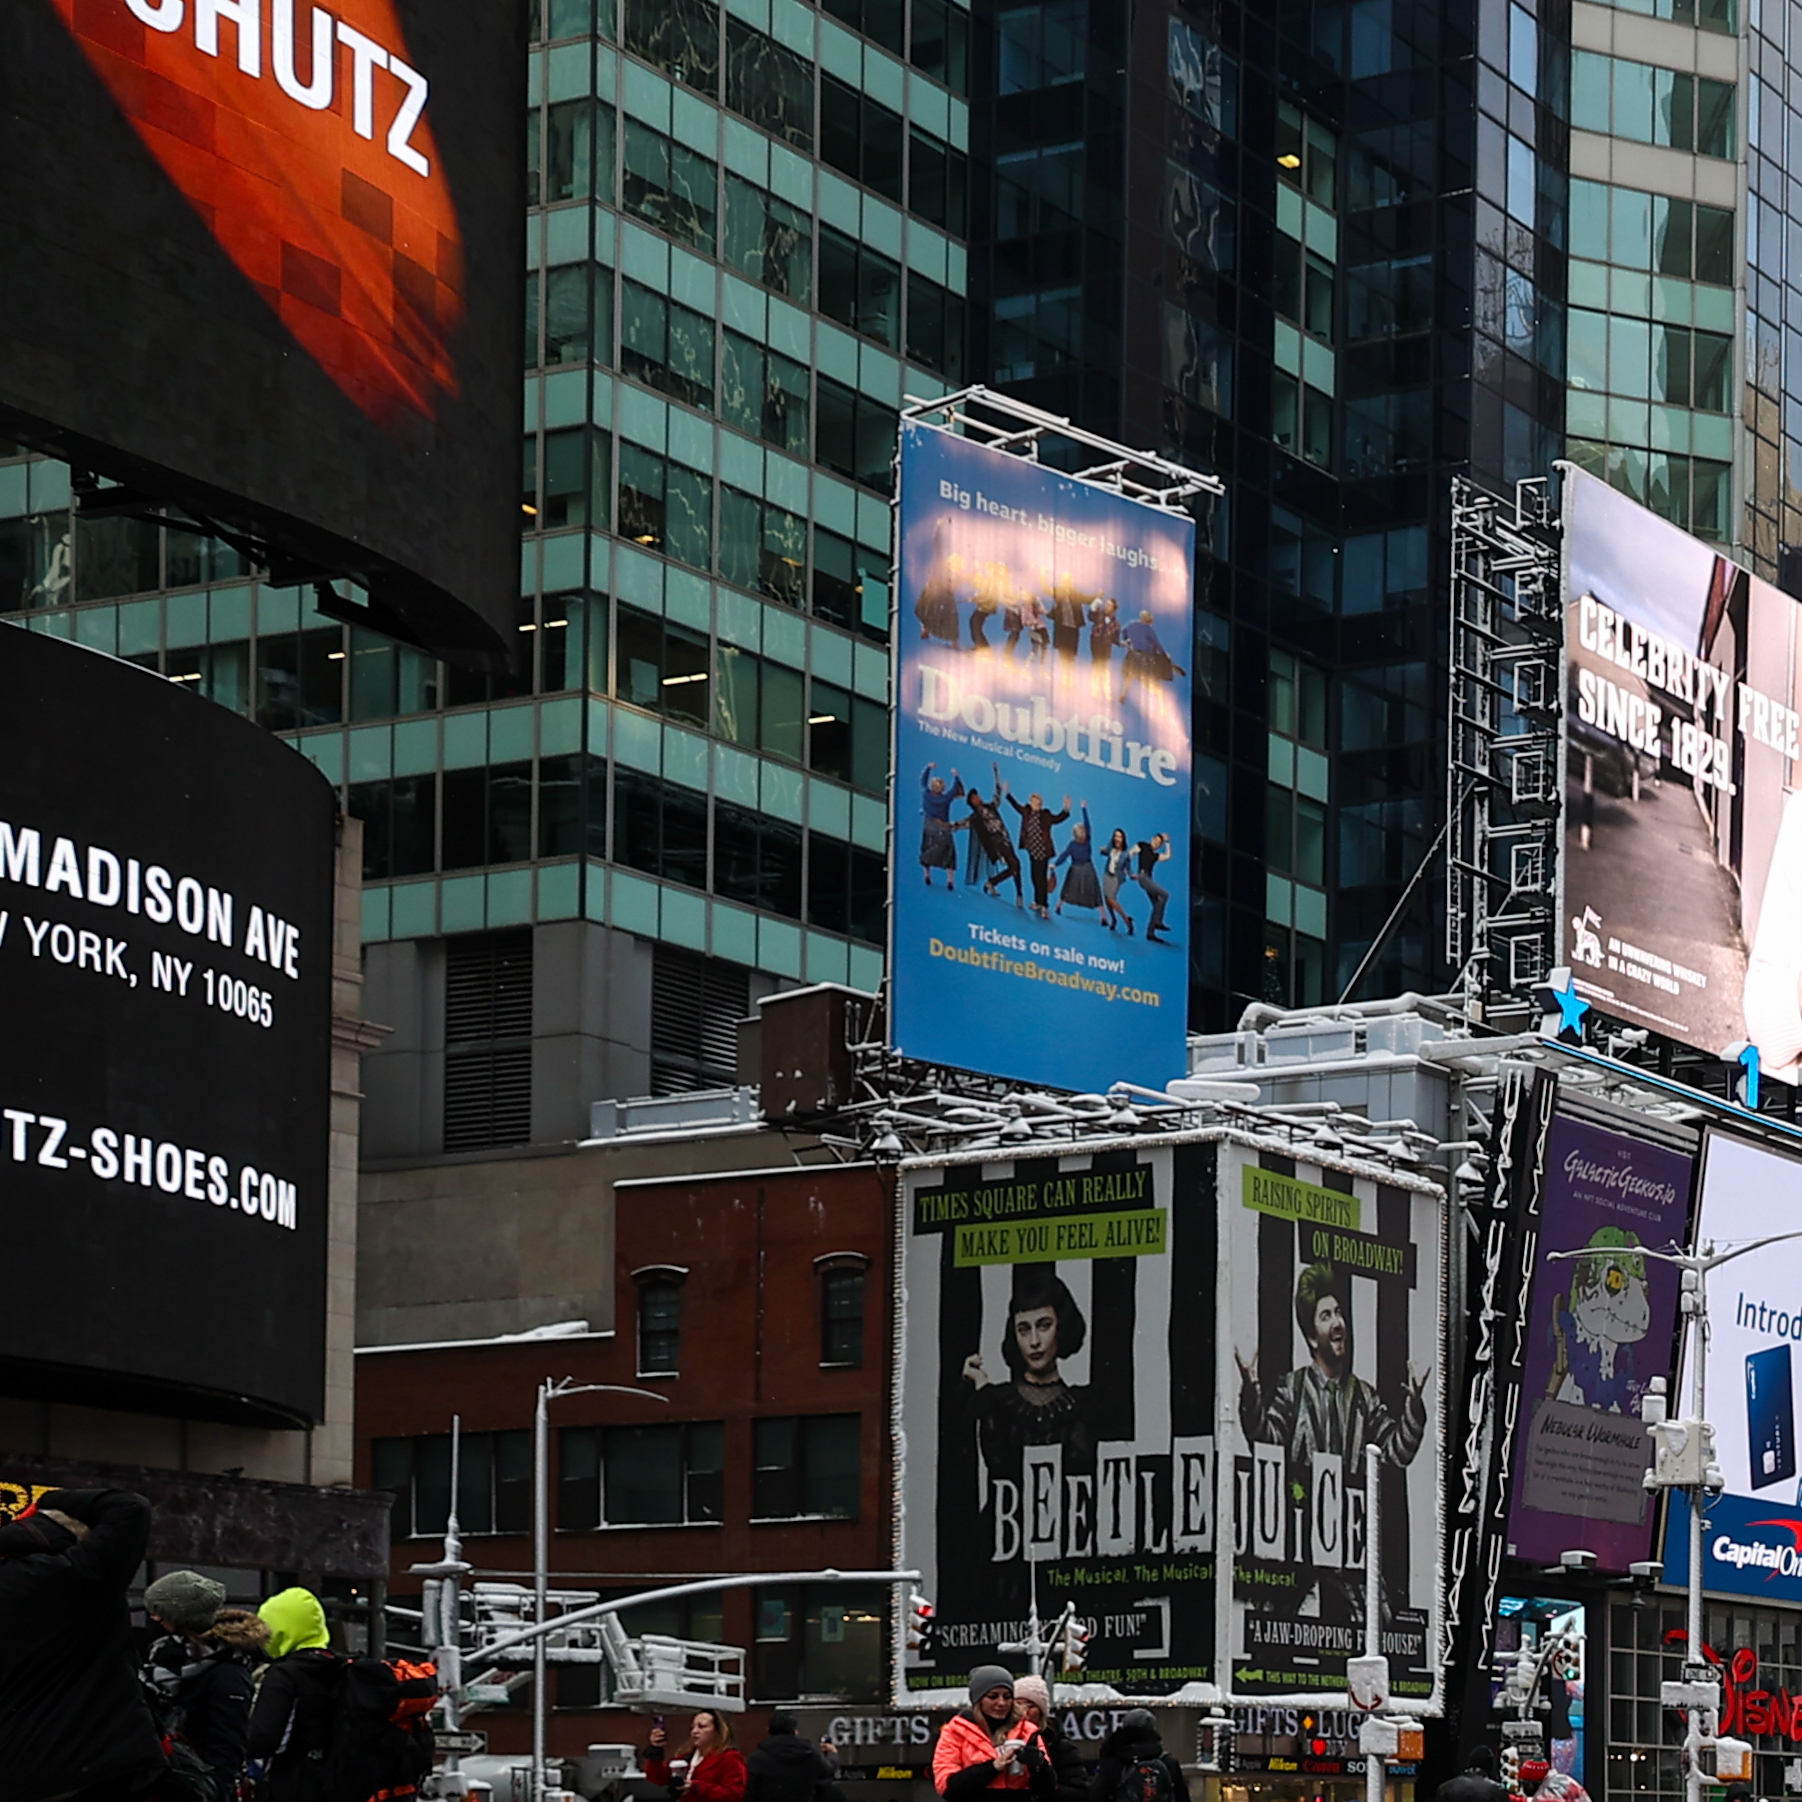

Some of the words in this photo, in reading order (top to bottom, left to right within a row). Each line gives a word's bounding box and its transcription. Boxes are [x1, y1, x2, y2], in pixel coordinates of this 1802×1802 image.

[939, 480, 970, 510] Big
[1038, 514, 1097, 549] bigger
[1578, 593, 1731, 723] CELEBRITY
[1737, 680, 1802, 763] FREE
[917, 663, 1177, 787] Doubtfire
[918, 720, 939, 738] The
[943, 728, 968, 746] New
[970, 735, 1014, 759] Musical
[1016, 748, 1062, 773] Comedy
[1577, 668, 1662, 760] SINCE
[1670, 717, 1738, 797] 1829.
[0, 822, 232, 949] MADISON
[245, 904, 300, 980] AVE
[24, 916, 138, 988] YORK,
[152, 953, 193, 998] NY
[203, 969, 273, 1029] 10065
[929, 938, 1160, 1007] DoubtfireBroadway.com
[968, 923, 1026, 953] Tickets
[1030, 938, 1049, 956] on
[1054, 942, 1087, 965] sale
[1091, 951, 1125, 974] now!
[1608, 937, 1620, 954] AN
[1622, 941, 1672, 975] UNWAVERING
[1673, 961, 1707, 989] WHISKEY
[1608, 955, 1618, 971] IN
[1619, 960, 1626, 974] A
[1626, 962, 1652, 985] CRAZY
[1652, 973, 1680, 996] WORLD
[919, 1191, 969, 1223] TIMES
[974, 1184, 1038, 1221] SQUARE
[1043, 1180, 1076, 1208] CAN
[1082, 1171, 1147, 1204] REALLY
[1253, 1176, 1302, 1214] RAISING
[1306, 1191, 1351, 1228] SPIRITS
[1595, 1197, 1616, 1211] SOCIAL
[1617, 1203, 1648, 1220] ADVENTURE
[961, 1228, 1010, 1258] MAKE
[1016, 1226, 1049, 1254] YOU
[1056, 1222, 1098, 1250] FEEL
[1104, 1216, 1161, 1247] ALIVE!
[1312, 1230, 1330, 1258] ON
[1333, 1234, 1404, 1275] BROADWAY!
[1048, 1569, 1070, 1586] The
[1074, 1567, 1128, 1586] Musical.
[1134, 1565, 1158, 1582] The
[1264, 1621, 1352, 1650] JAW-DROPPING
[1158, 1666, 1208, 1680] BROADWAY
[828, 1716, 930, 1745] GIFTS
[1233, 1707, 1299, 1737] GIFTS
[877, 1766, 913, 1779] Nikon
[1268, 1757, 1298, 1771] Nikon
[1302, 1758, 1343, 1773] Canon
